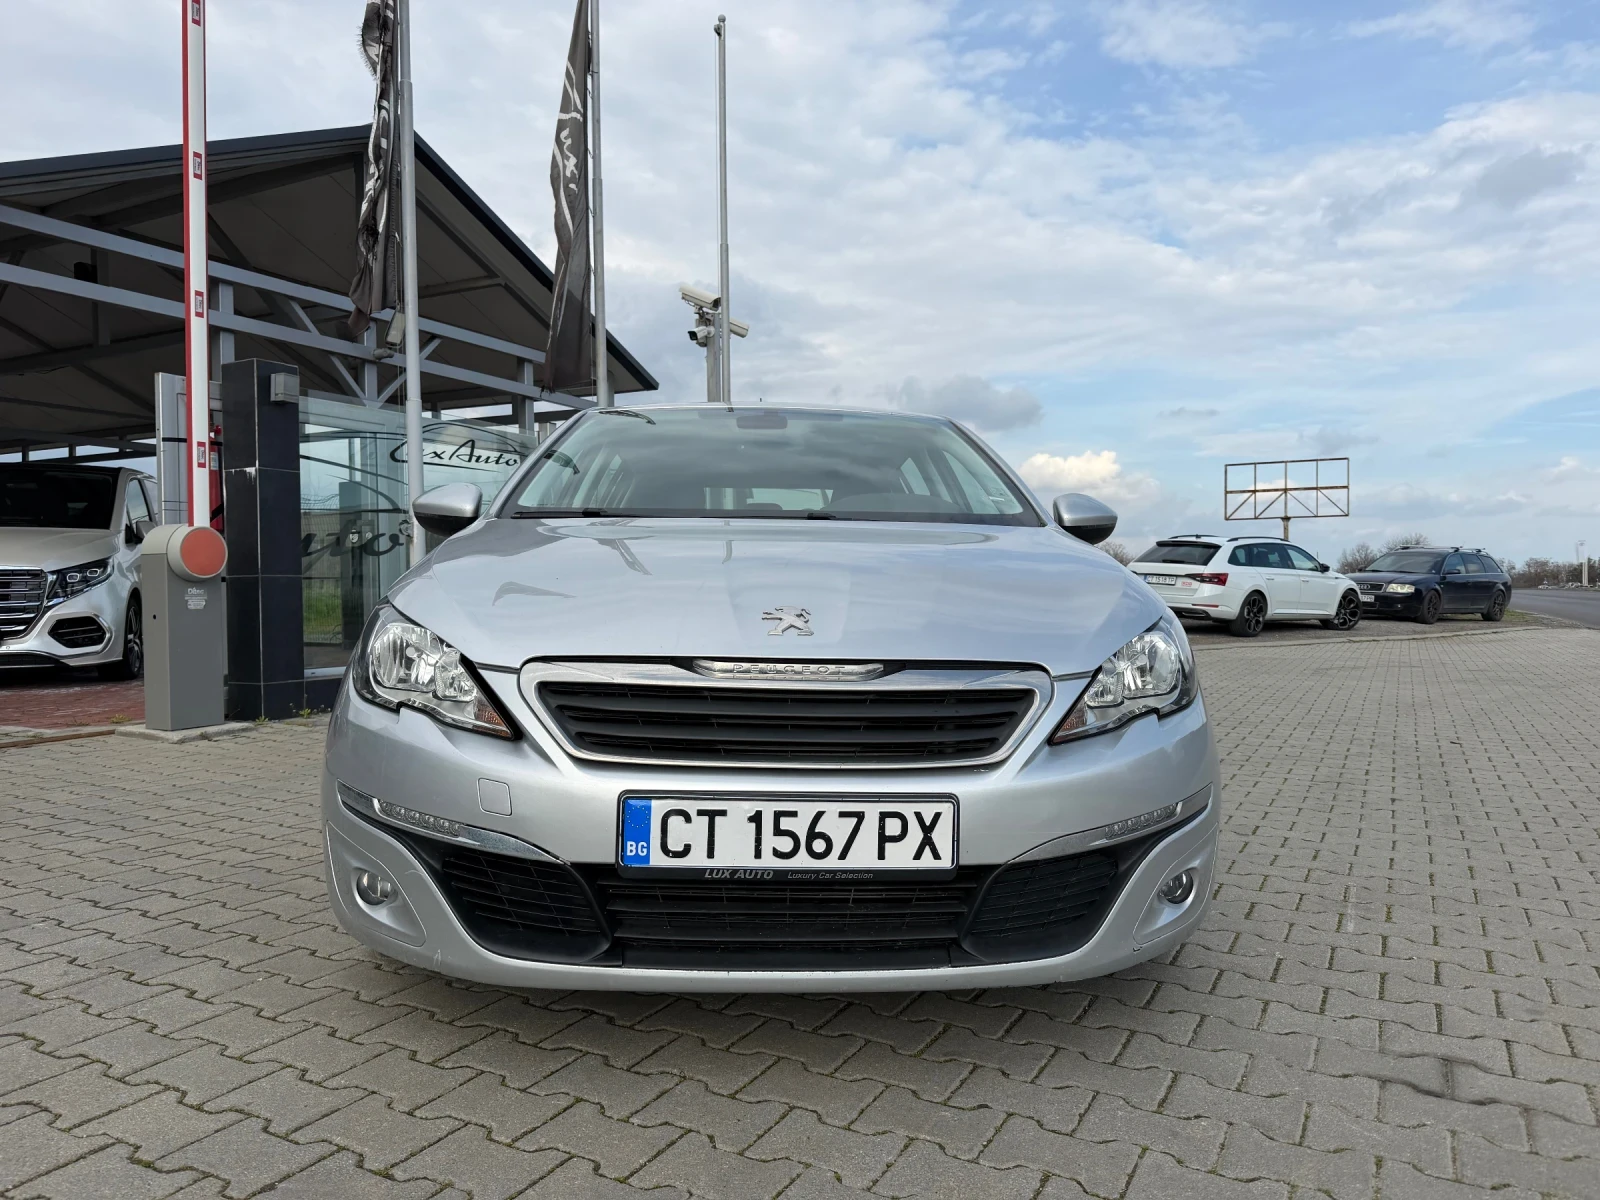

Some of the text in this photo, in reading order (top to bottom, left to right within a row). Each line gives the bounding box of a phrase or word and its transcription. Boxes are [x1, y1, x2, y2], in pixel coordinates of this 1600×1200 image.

[449, 439, 518, 466] Auto
[733, 664, 845, 675] PEUGEOT
[660, 808, 943, 861] CT 1567 PX
[626, 841, 648, 857] BG
[704, 868, 874, 880] LUX AUTO Luxury Car Selection
